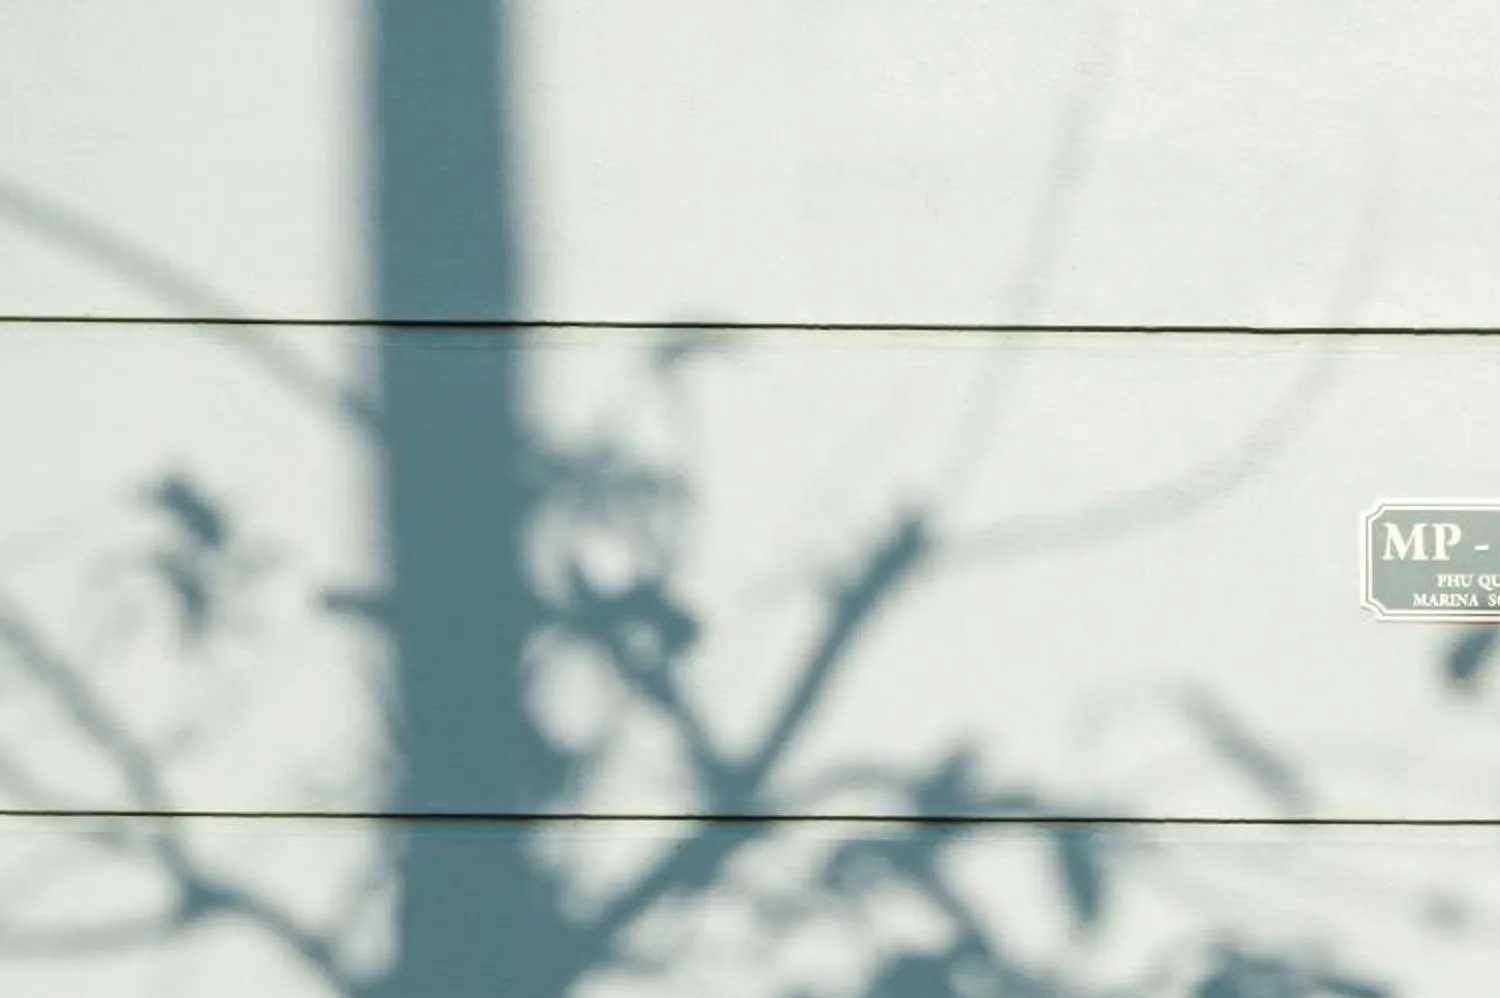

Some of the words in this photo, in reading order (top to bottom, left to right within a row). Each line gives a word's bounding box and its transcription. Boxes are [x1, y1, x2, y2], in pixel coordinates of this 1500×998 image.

[1381, 523, 1462, 561] MP
[1436, 573, 1474, 588] PHU
[1413, 593, 1478, 607] MARINA
